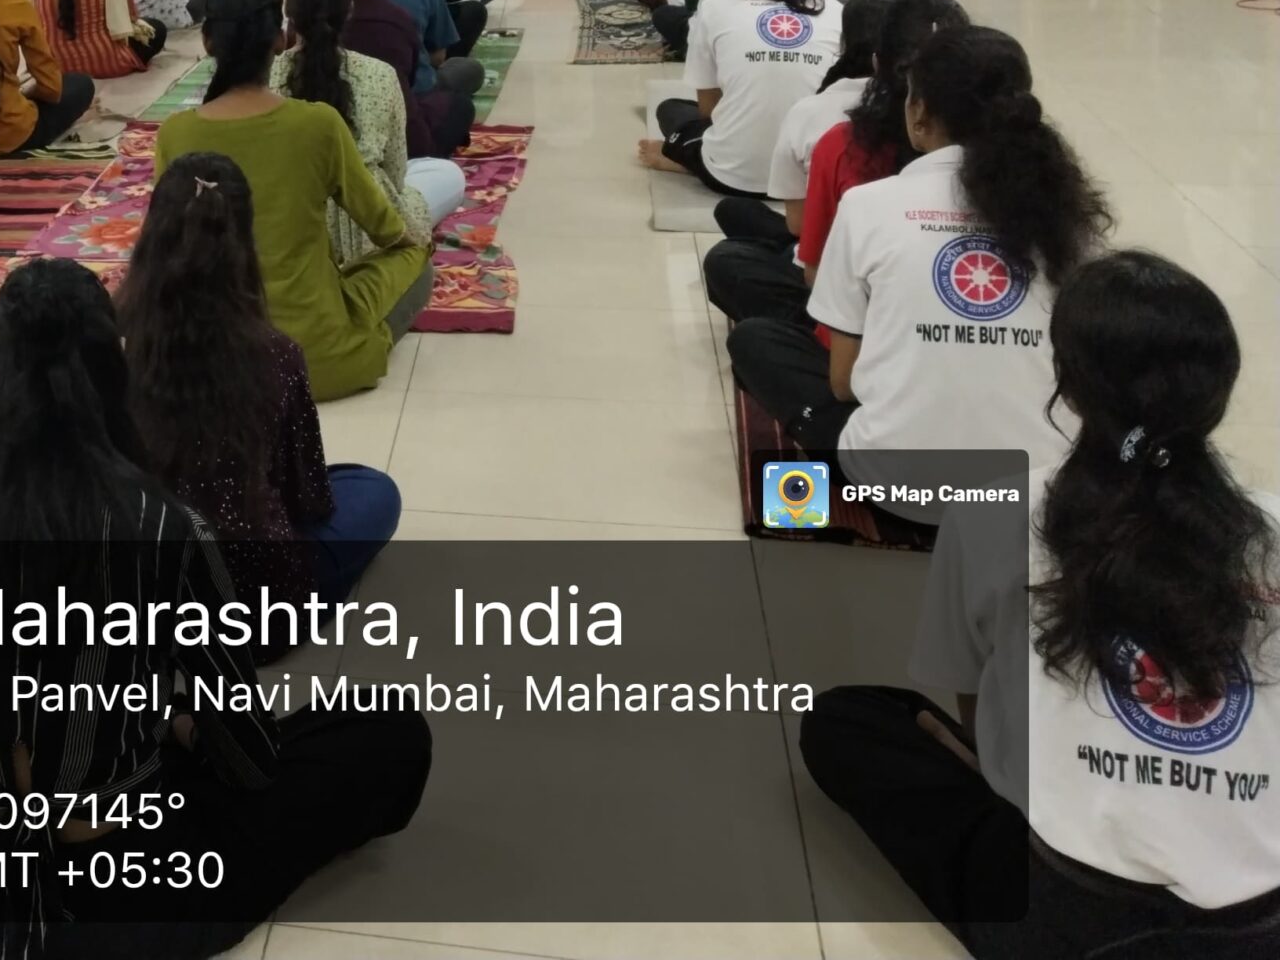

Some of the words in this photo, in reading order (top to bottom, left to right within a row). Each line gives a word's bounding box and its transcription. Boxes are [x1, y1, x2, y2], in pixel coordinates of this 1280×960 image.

[769, 51, 781, 62] ME
[783, 51, 800, 63] BUT
[941, 275, 967, 310] NATIONAL
[967, 302, 1002, 315] SERVICE
[955, 324, 976, 345] ME
[979, 326, 1008, 345] BUT
[1153, 724, 1211, 742] SERVICE
[1210, 692, 1242, 736] SCHEME
[1135, 754, 1163, 785] ME
[1170, 758, 1218, 795] BUT
